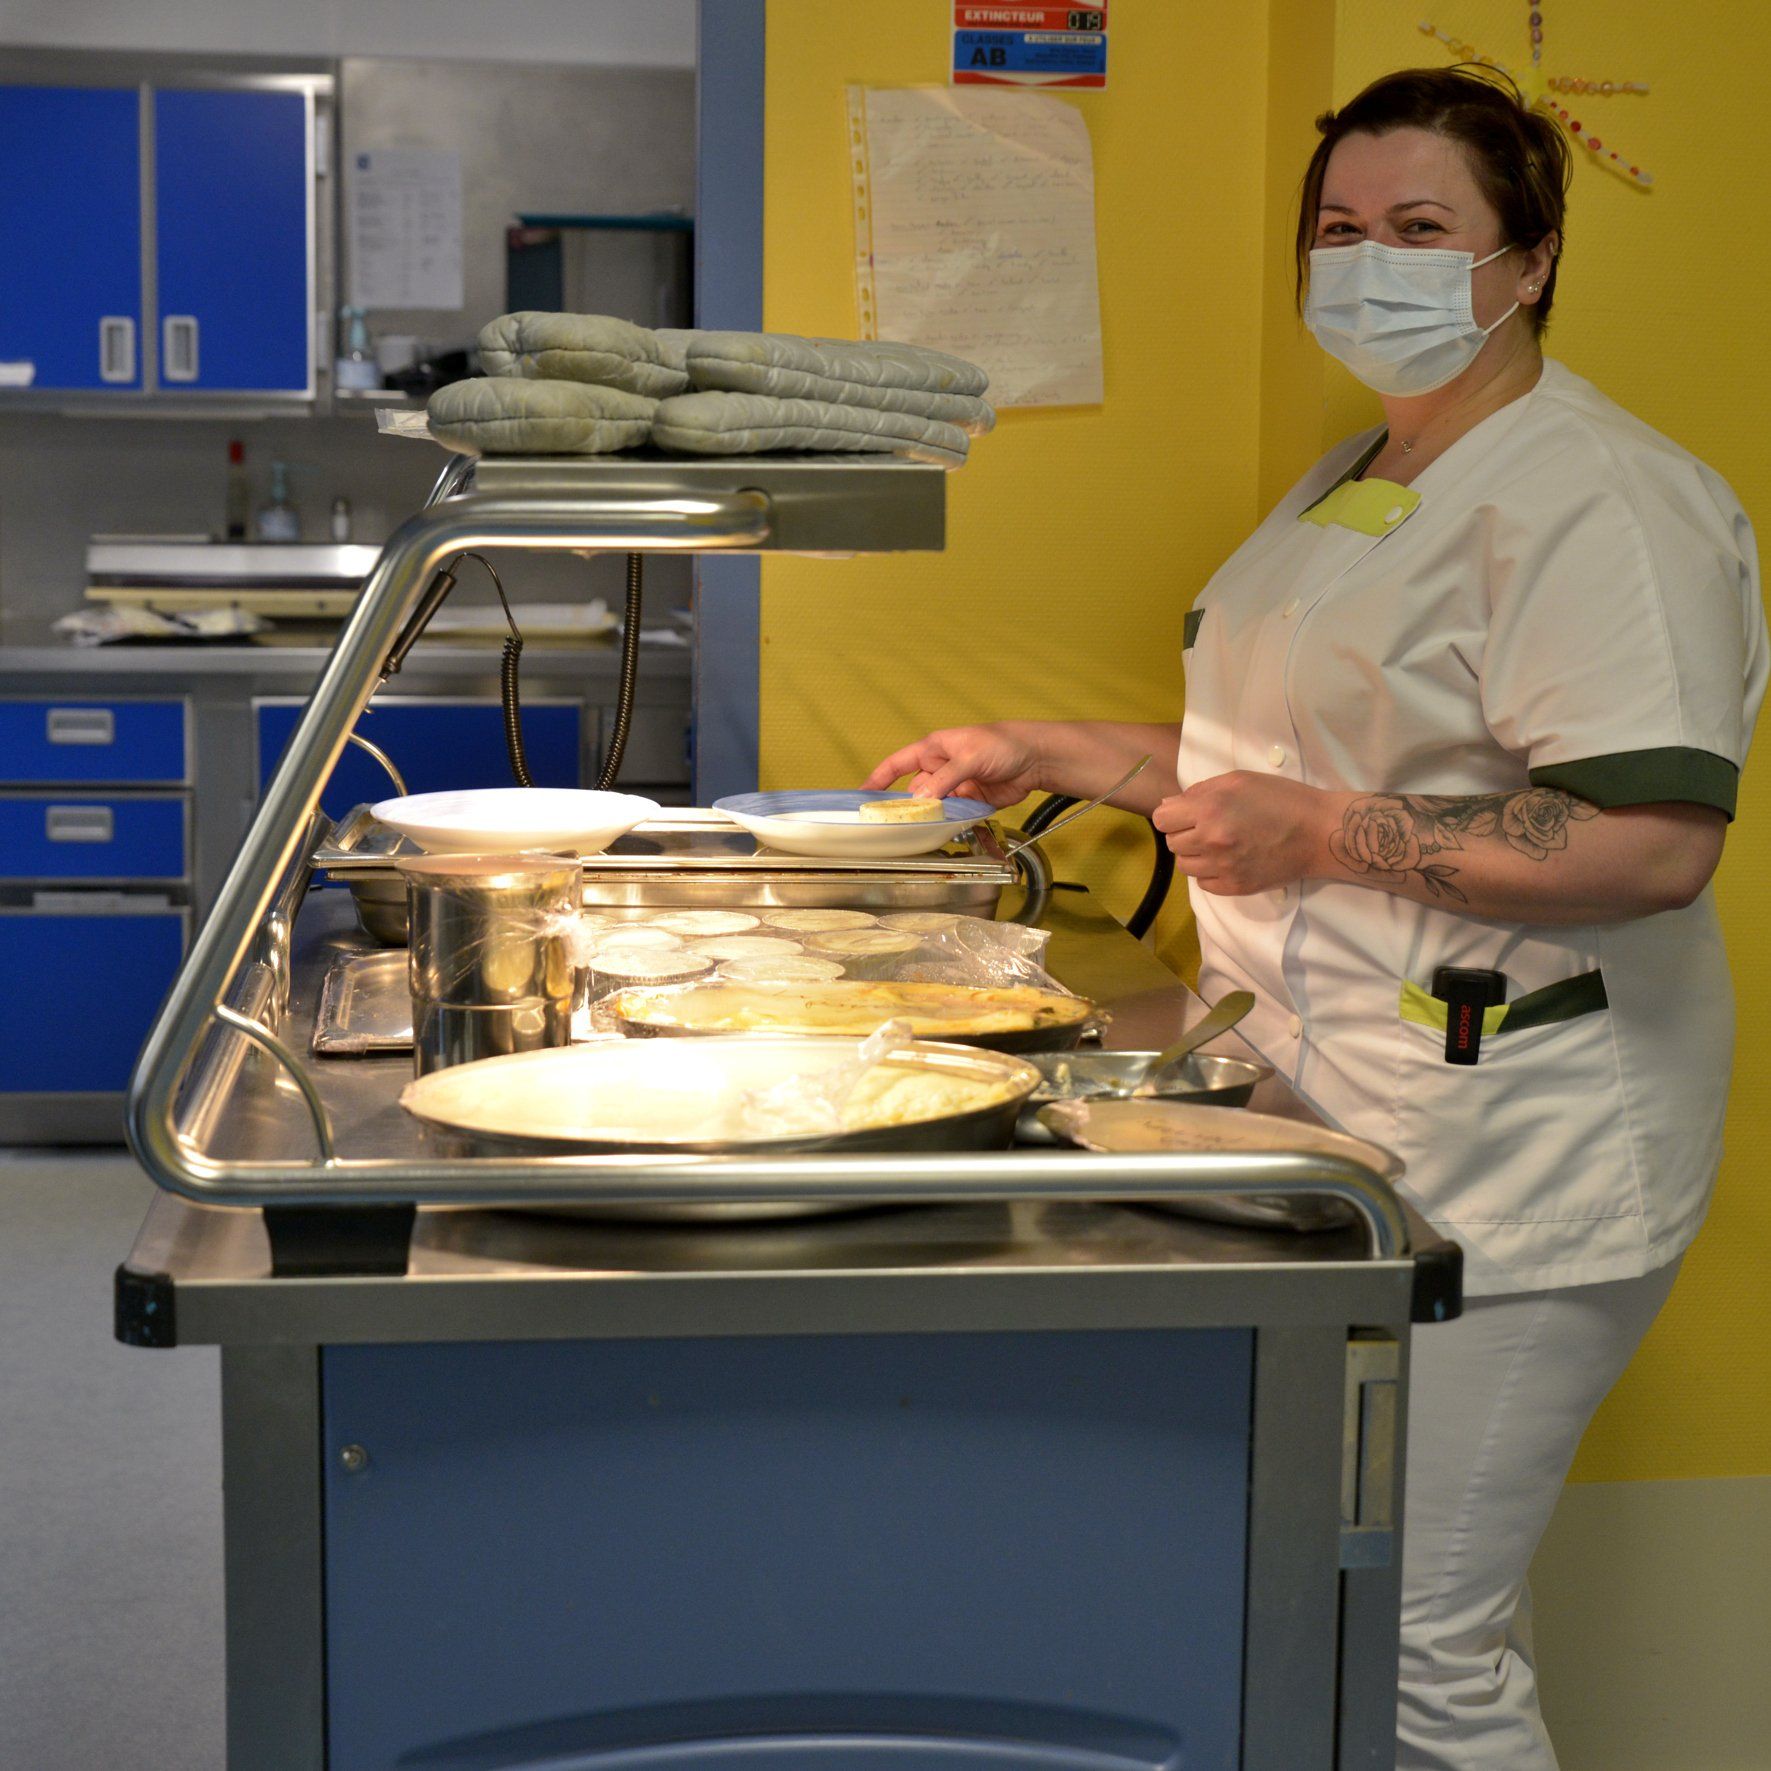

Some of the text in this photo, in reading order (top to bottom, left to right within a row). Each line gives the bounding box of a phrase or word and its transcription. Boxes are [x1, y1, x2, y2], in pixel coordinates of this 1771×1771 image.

[964, 10, 1044, 22] EXTINCTEUR
[961, 33, 1014, 45] CLASSES
[971, 48, 1006, 65] AB
[1458, 1004, 1471, 1049] ascom
